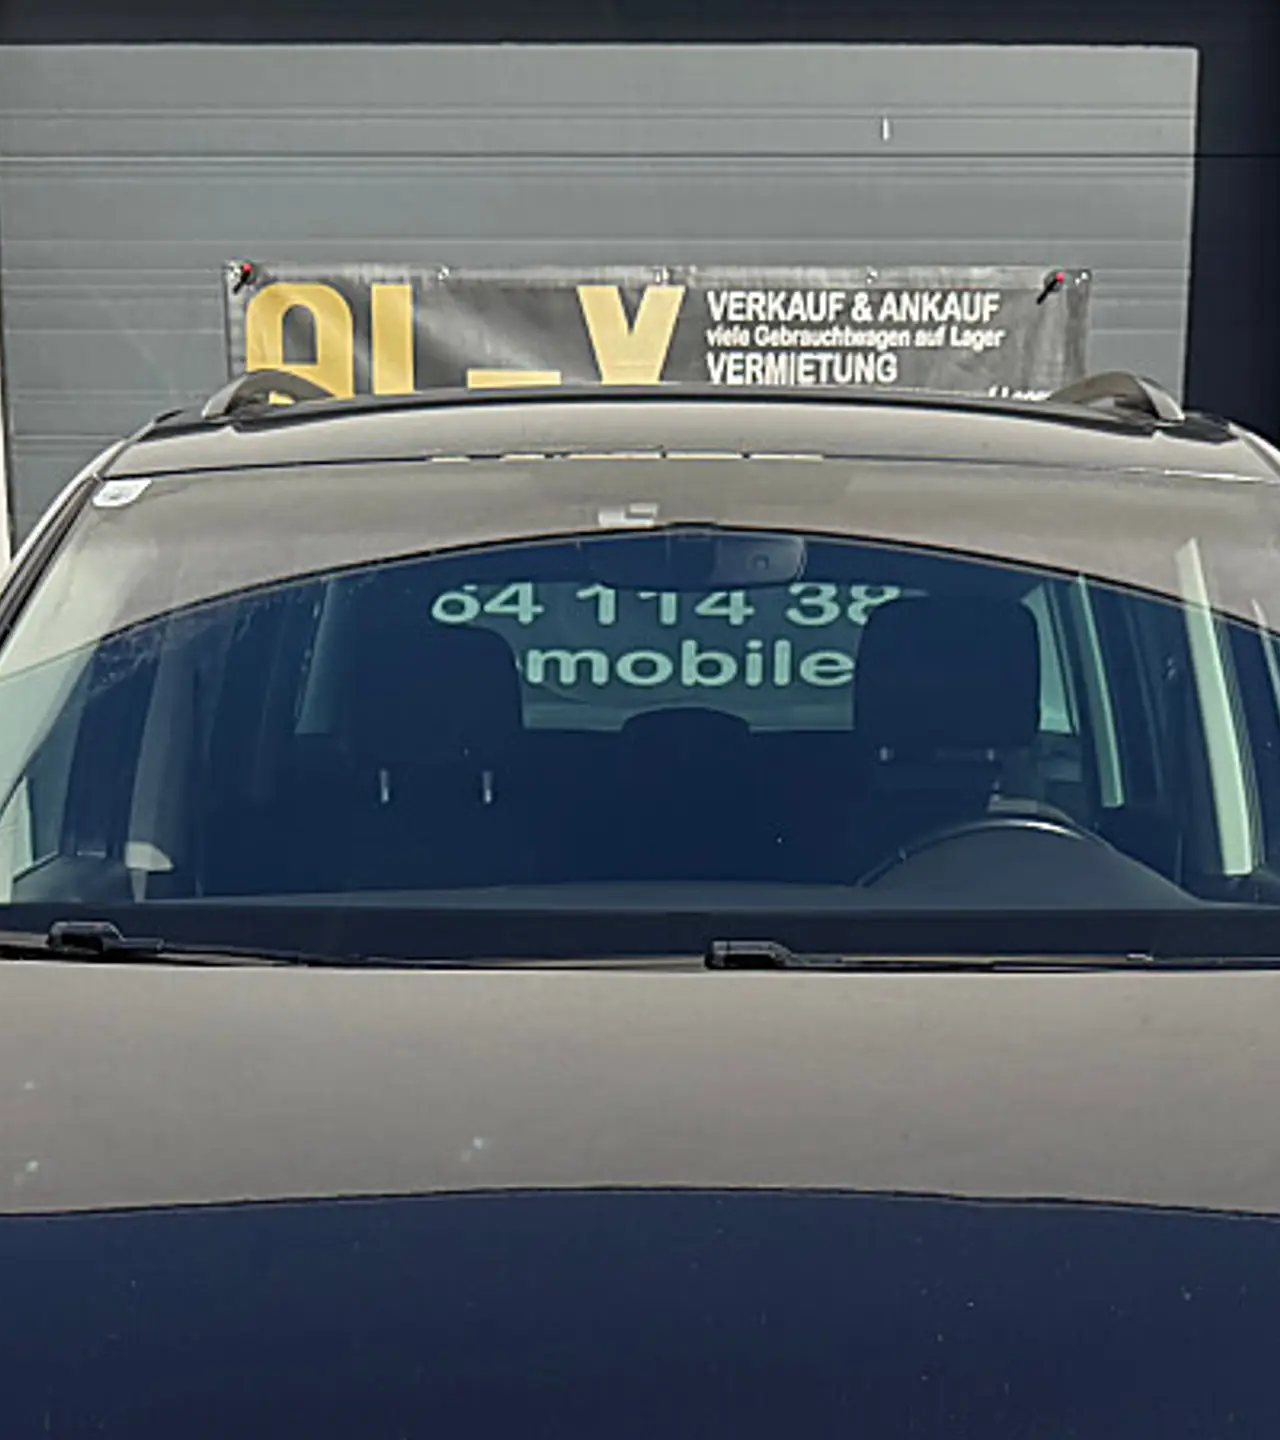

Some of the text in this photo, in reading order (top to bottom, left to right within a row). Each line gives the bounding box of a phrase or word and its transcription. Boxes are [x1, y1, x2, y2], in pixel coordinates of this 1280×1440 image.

[706, 290, 1000, 323] VERKAUF & ANKAUF
[706, 325, 1006, 352] viele Gebrauchtwagen auf Lager
[706, 352, 898, 386] VERMIETUNG
[575, 582, 756, 625] 114
